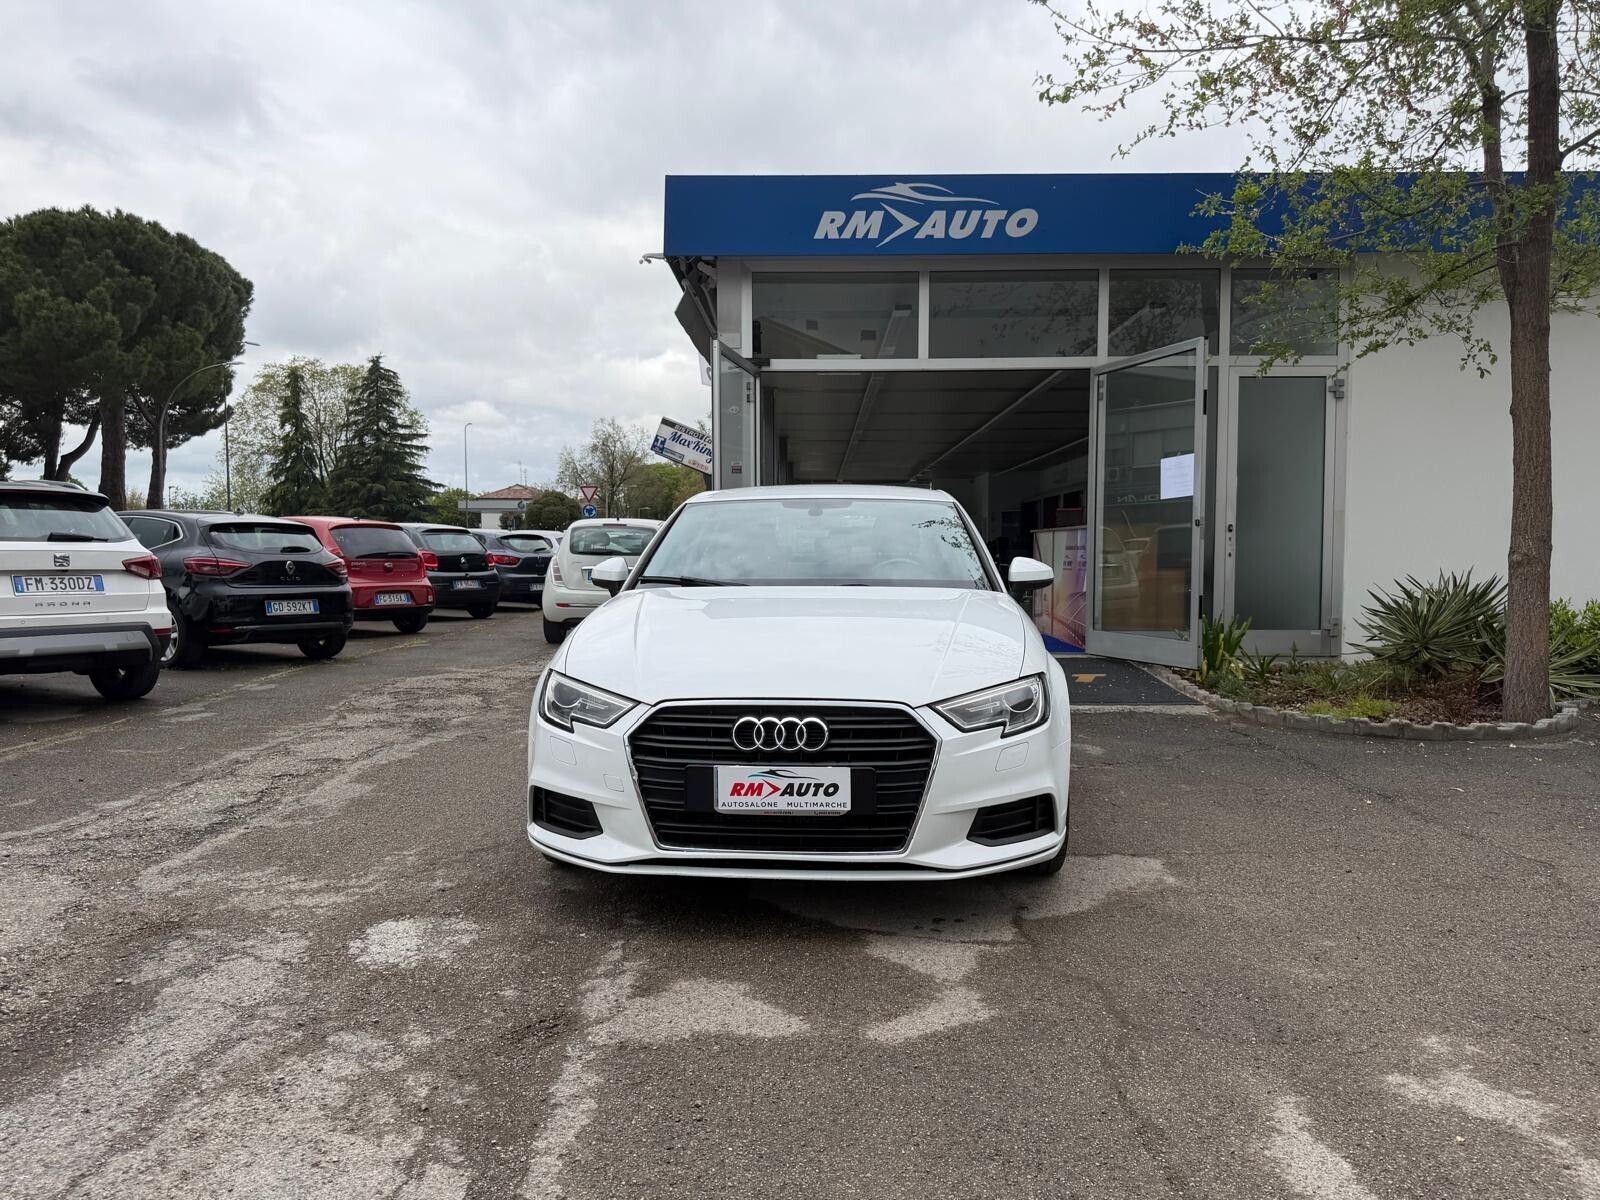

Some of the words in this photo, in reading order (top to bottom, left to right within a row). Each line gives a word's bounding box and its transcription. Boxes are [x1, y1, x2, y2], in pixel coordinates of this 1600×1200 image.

[813, 210, 885, 240] RM
[913, 207, 1039, 240] AUTO
[24, 577, 45, 592] FM
[48, 576, 95, 591] 330DZ
[34, 600, 91, 608] ARONA
[729, 782, 764, 797] RM
[780, 782, 839, 797] AUTO
